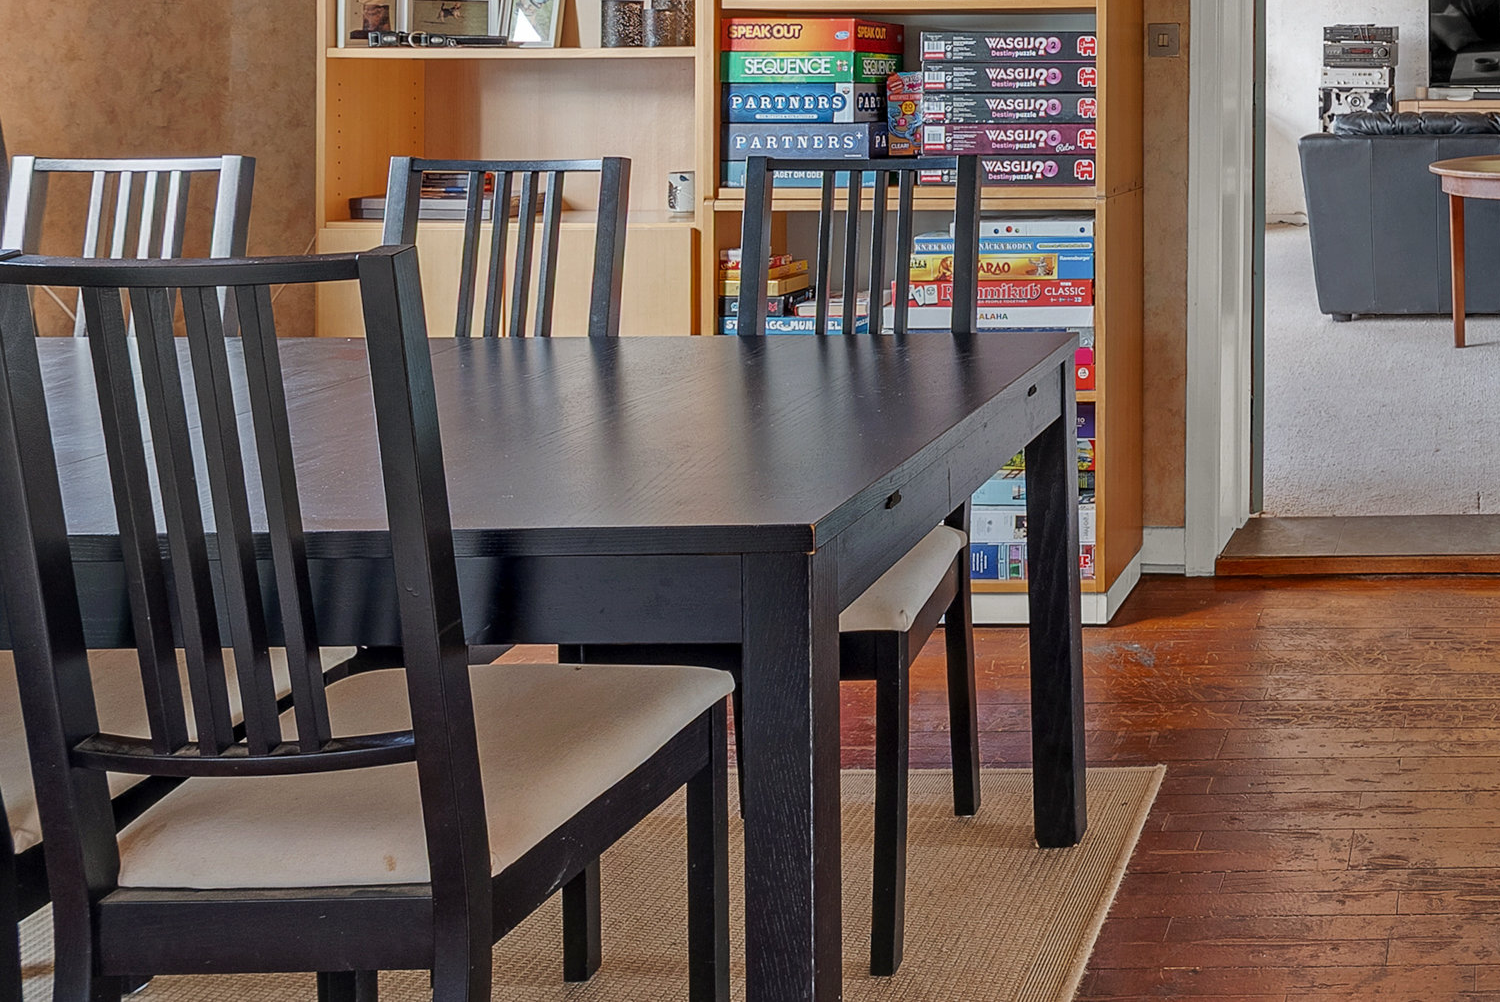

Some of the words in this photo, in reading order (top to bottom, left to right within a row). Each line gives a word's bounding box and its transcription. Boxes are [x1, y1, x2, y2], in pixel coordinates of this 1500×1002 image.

[729, 24, 771, 39] SPEAK
[772, 24, 802, 38] OUT
[857, 26, 875, 39] SPEAK
[875, 27, 887, 39] OUT
[744, 58, 831, 75] SEQUENCE
[863, 59, 896, 75] SEQUENCE
[731, 96, 843, 109] PARTNERS
[858, 96, 881, 109] PART
[979, 241, 1005, 251] NÄCKA
[1005, 242, 1033, 250] KODEN
[978, 261, 1010, 275] ARAO
[941, 283, 1042, 301] Rmikub
[1044, 286, 1086, 296] CLASSIC
